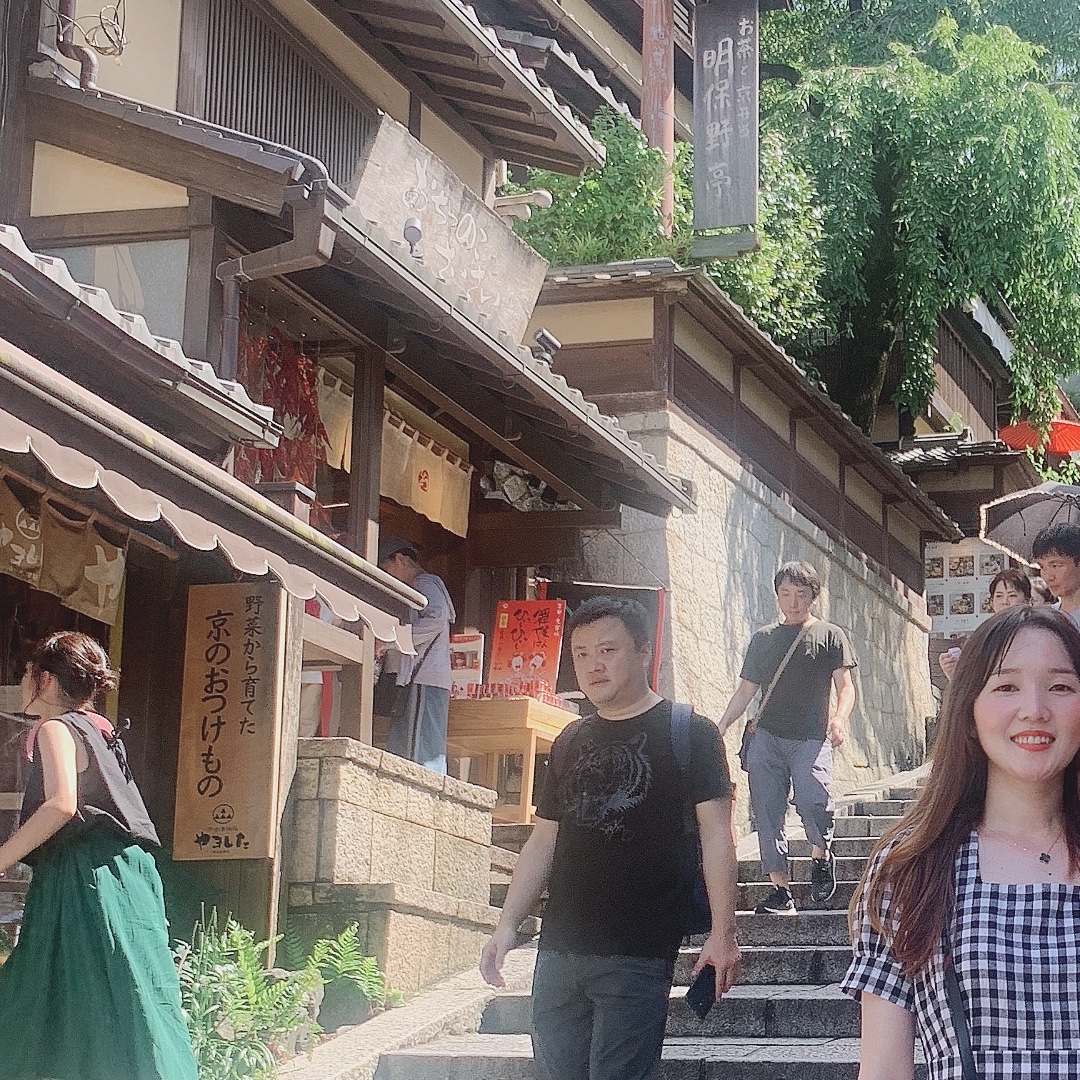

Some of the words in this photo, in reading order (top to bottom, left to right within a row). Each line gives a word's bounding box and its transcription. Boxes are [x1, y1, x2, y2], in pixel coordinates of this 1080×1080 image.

[702, 37, 734, 199] 明保野亭
[197, 609, 234, 798] 京のおつけもの
[239, 595, 263, 735] 野菜から育てた
